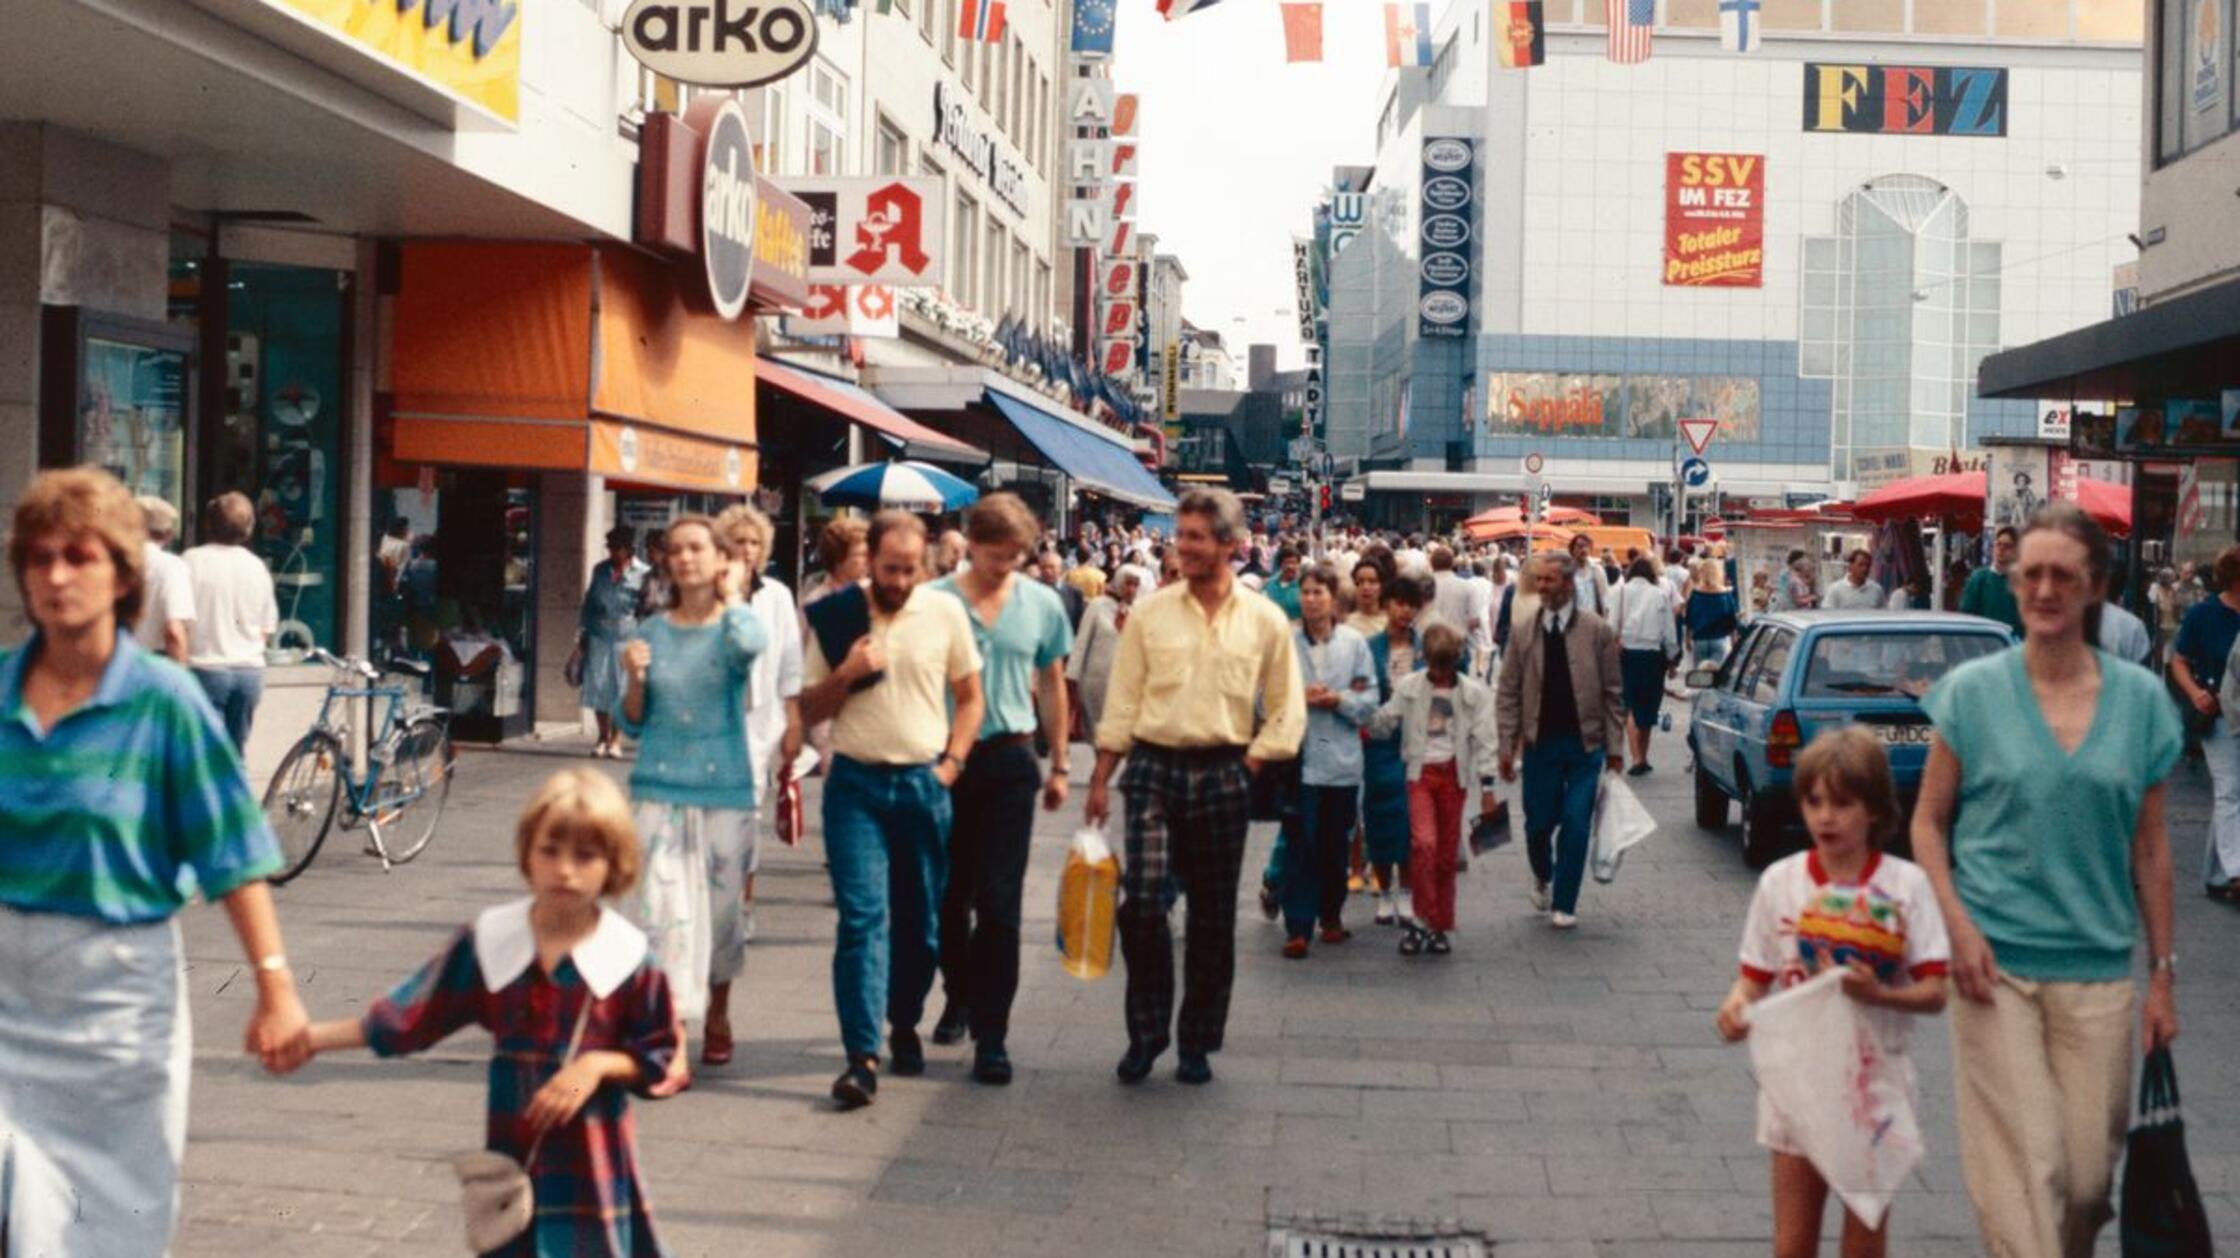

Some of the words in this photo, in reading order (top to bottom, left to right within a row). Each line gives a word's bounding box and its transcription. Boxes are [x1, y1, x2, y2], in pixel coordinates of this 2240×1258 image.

[633, 0, 805, 53] arko
[1813, 65, 2000, 135] FEZ
[1681, 154, 1757, 187] SSV
[708, 147, 752, 250] arko
[1679, 187, 1706, 207] IM
[1713, 188, 1752, 208] FEZ
[1678, 225, 1742, 255] Totaler
[1667, 248, 1761, 283] Preissturz
